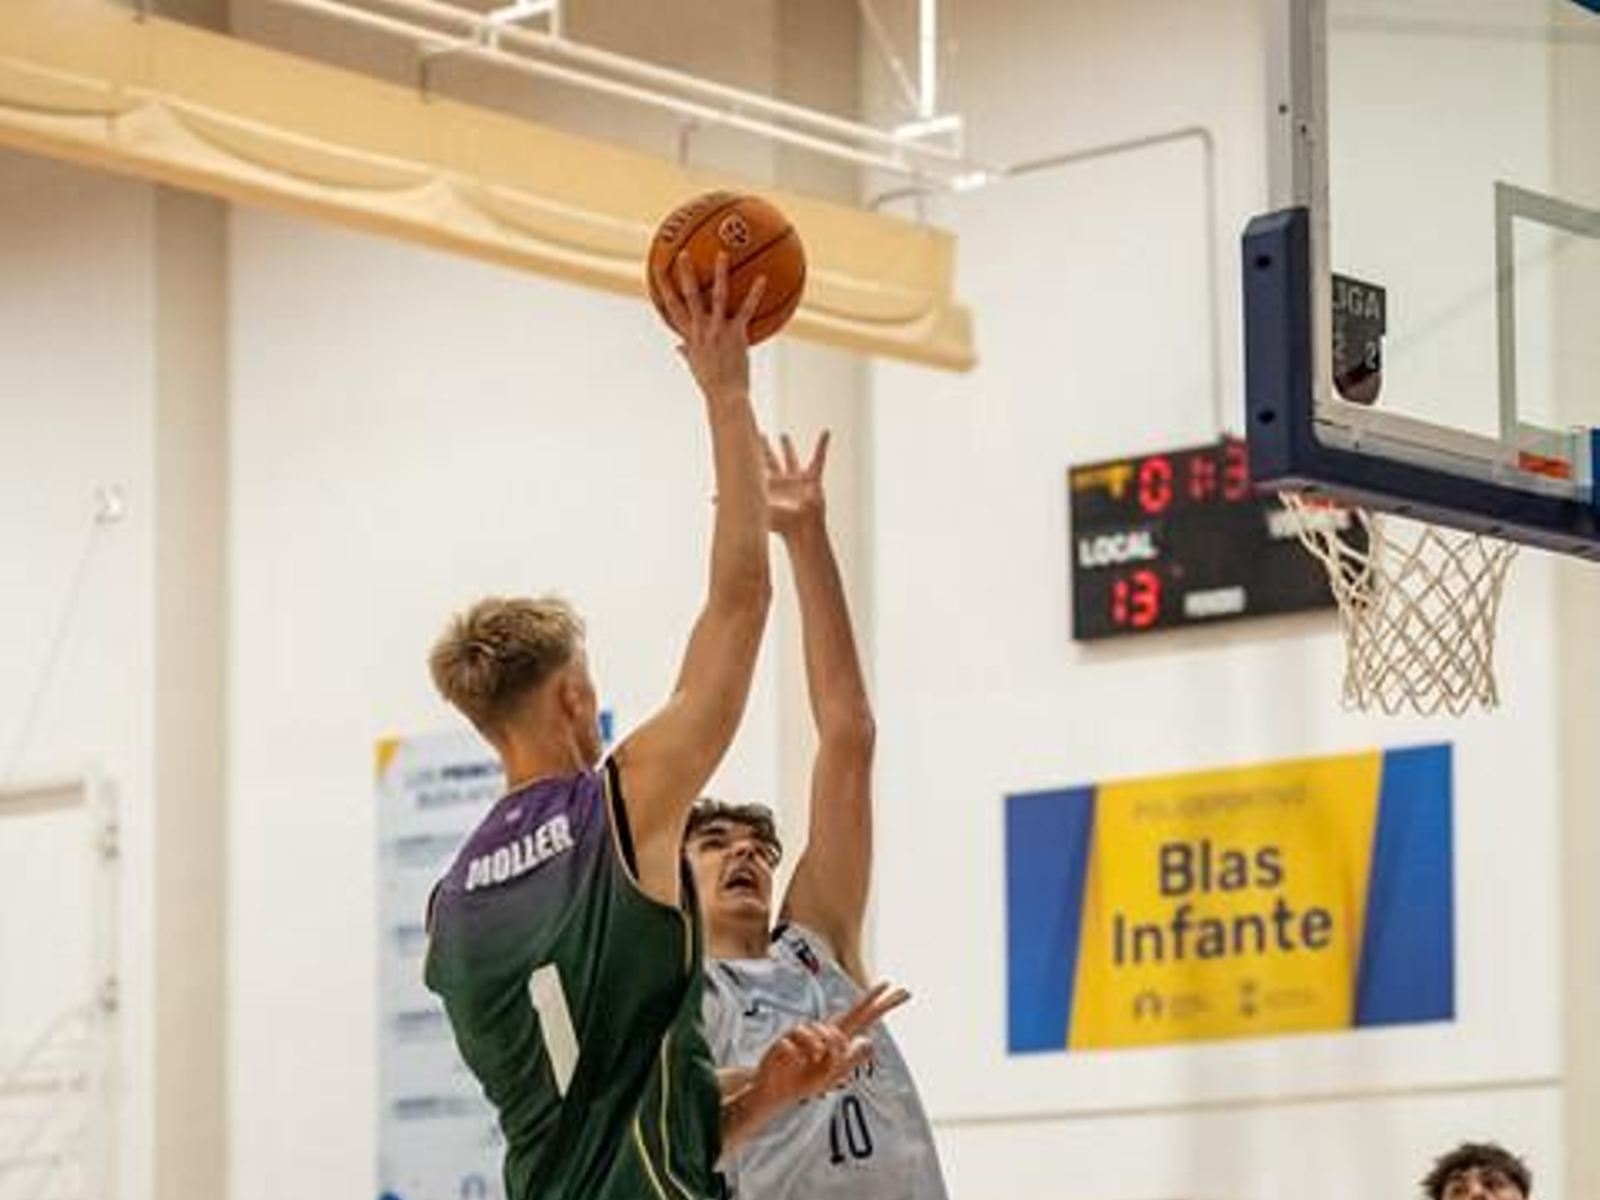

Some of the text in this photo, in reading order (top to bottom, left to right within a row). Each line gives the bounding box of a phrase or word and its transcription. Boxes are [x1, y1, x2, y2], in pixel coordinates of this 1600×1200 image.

[1079, 532, 1159, 568] LOCAL
[1111, 568, 1161, 628] 13
[1158, 838, 1285, 898] Blas
[1112, 898, 1333, 967] Infante
[527, 961, 581, 1099] 1
[829, 1094, 874, 1166] 10
